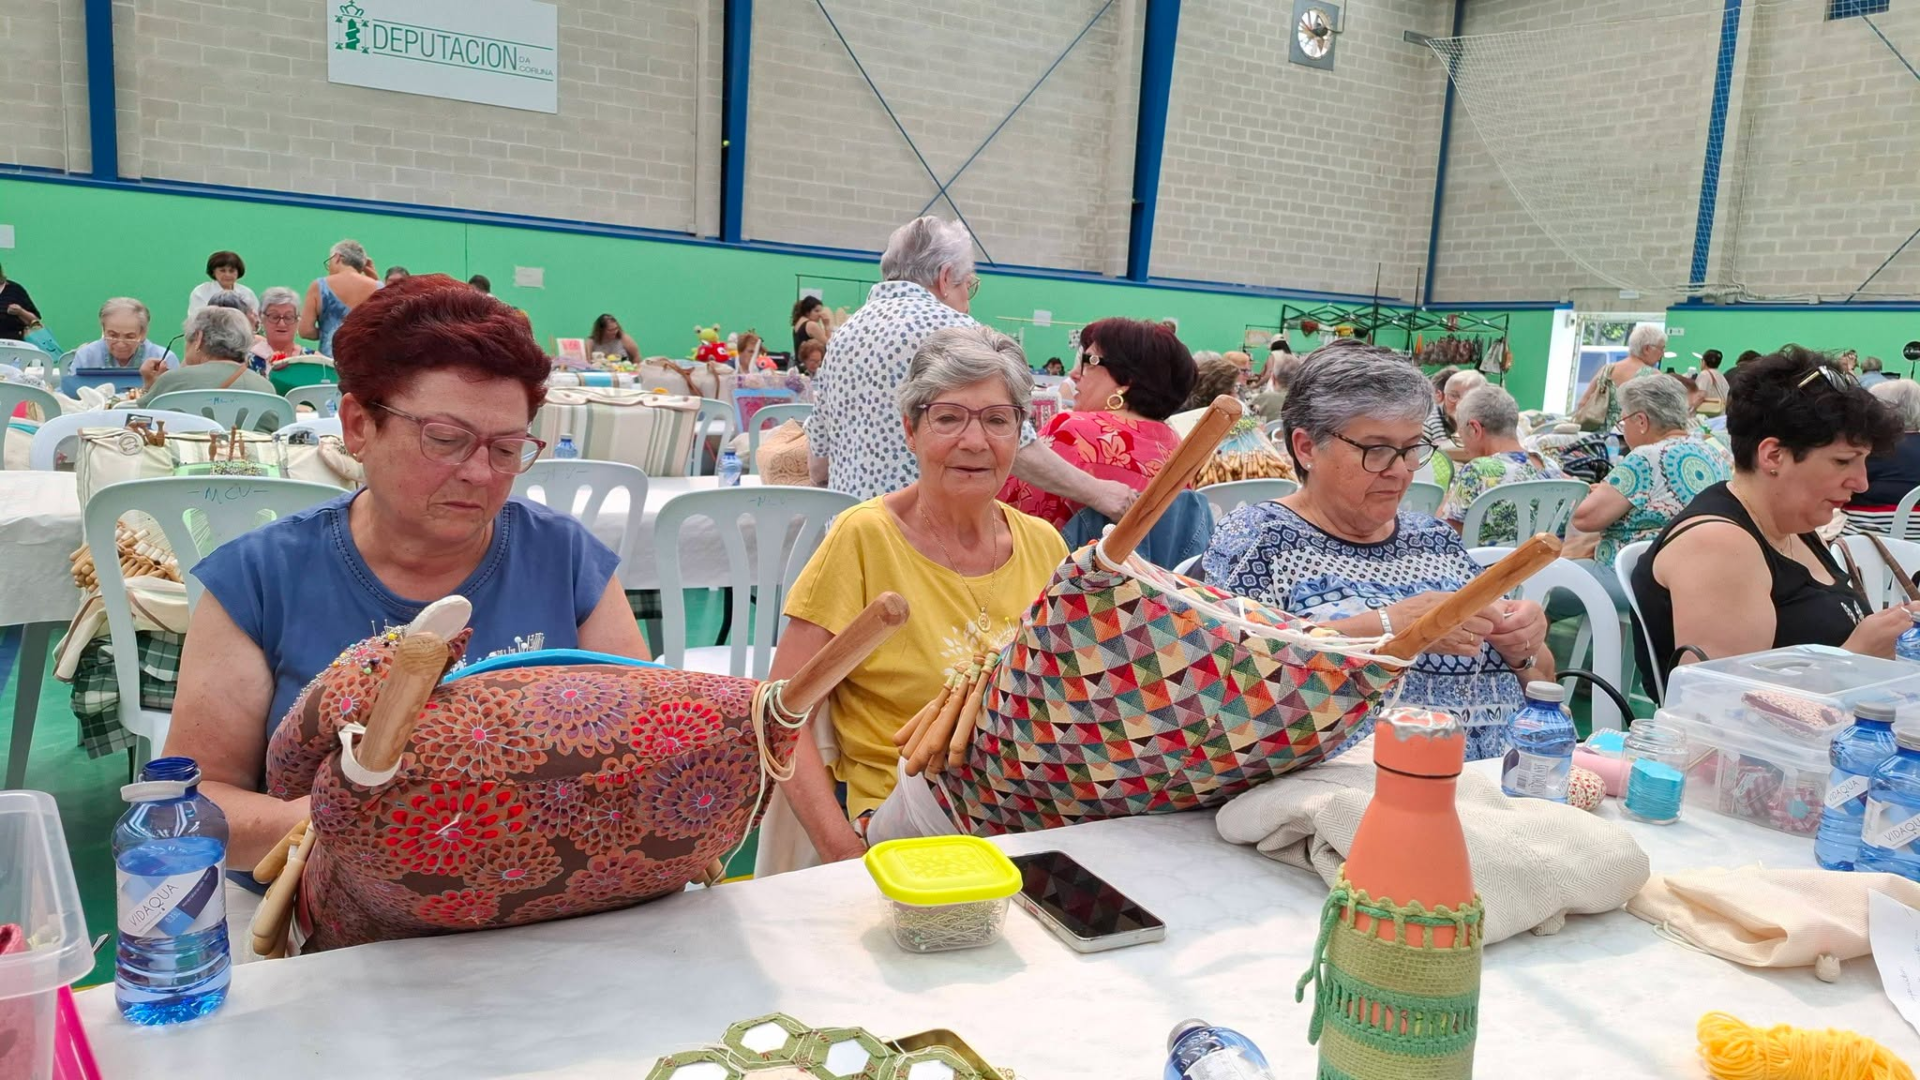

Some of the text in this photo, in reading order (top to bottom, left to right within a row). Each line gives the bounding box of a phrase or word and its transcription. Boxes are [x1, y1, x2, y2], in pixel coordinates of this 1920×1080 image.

[373, 24, 517, 70] DEPUTACION
[519, 56, 531, 64] DA
[1827, 779, 1860, 801] VIDAQUA
[1883, 816, 1920, 842] VIDAQU
[128, 883, 180, 927] VIDAQUA
